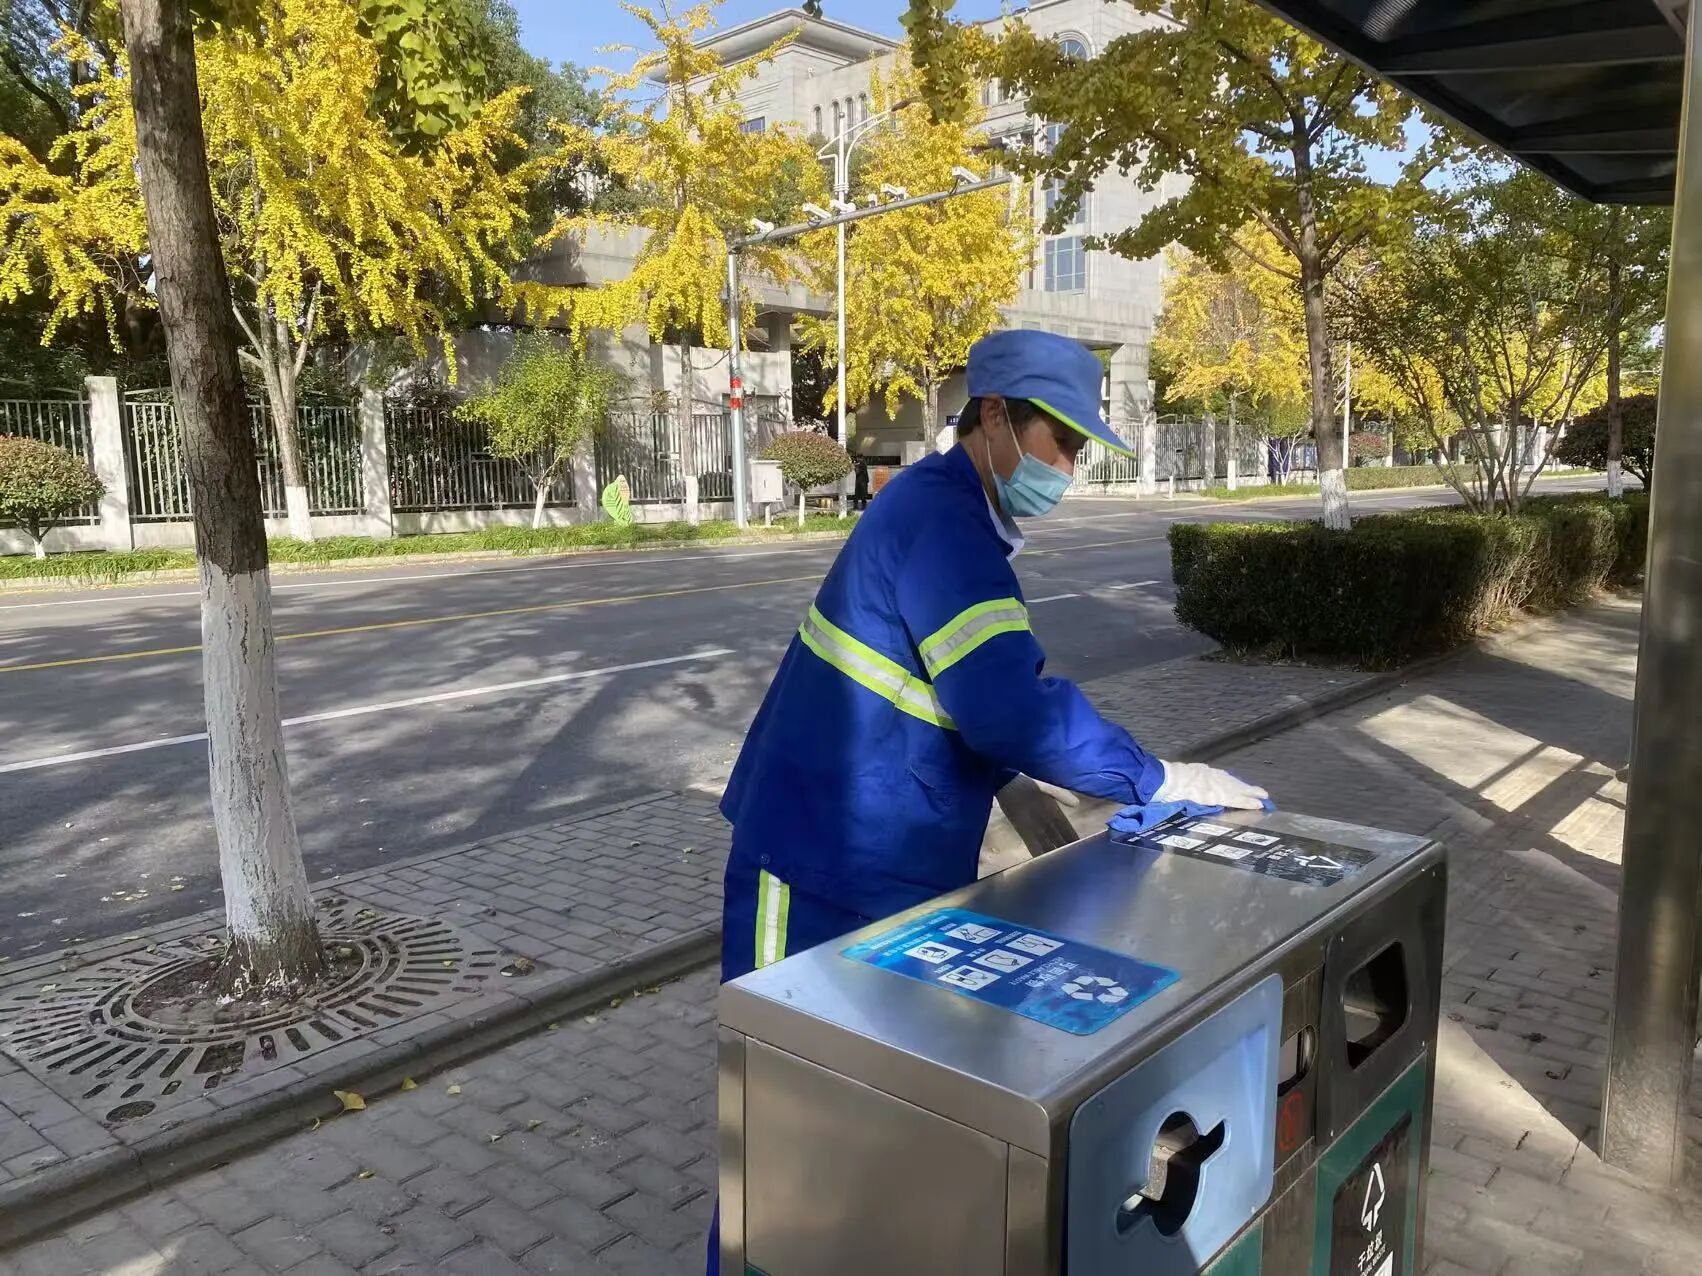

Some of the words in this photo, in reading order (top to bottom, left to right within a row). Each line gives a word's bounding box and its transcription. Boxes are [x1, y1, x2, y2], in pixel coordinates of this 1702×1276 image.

[1025, 962, 1079, 987] 可回收物
[1358, 1229, 1382, 1271] 干垃圾
